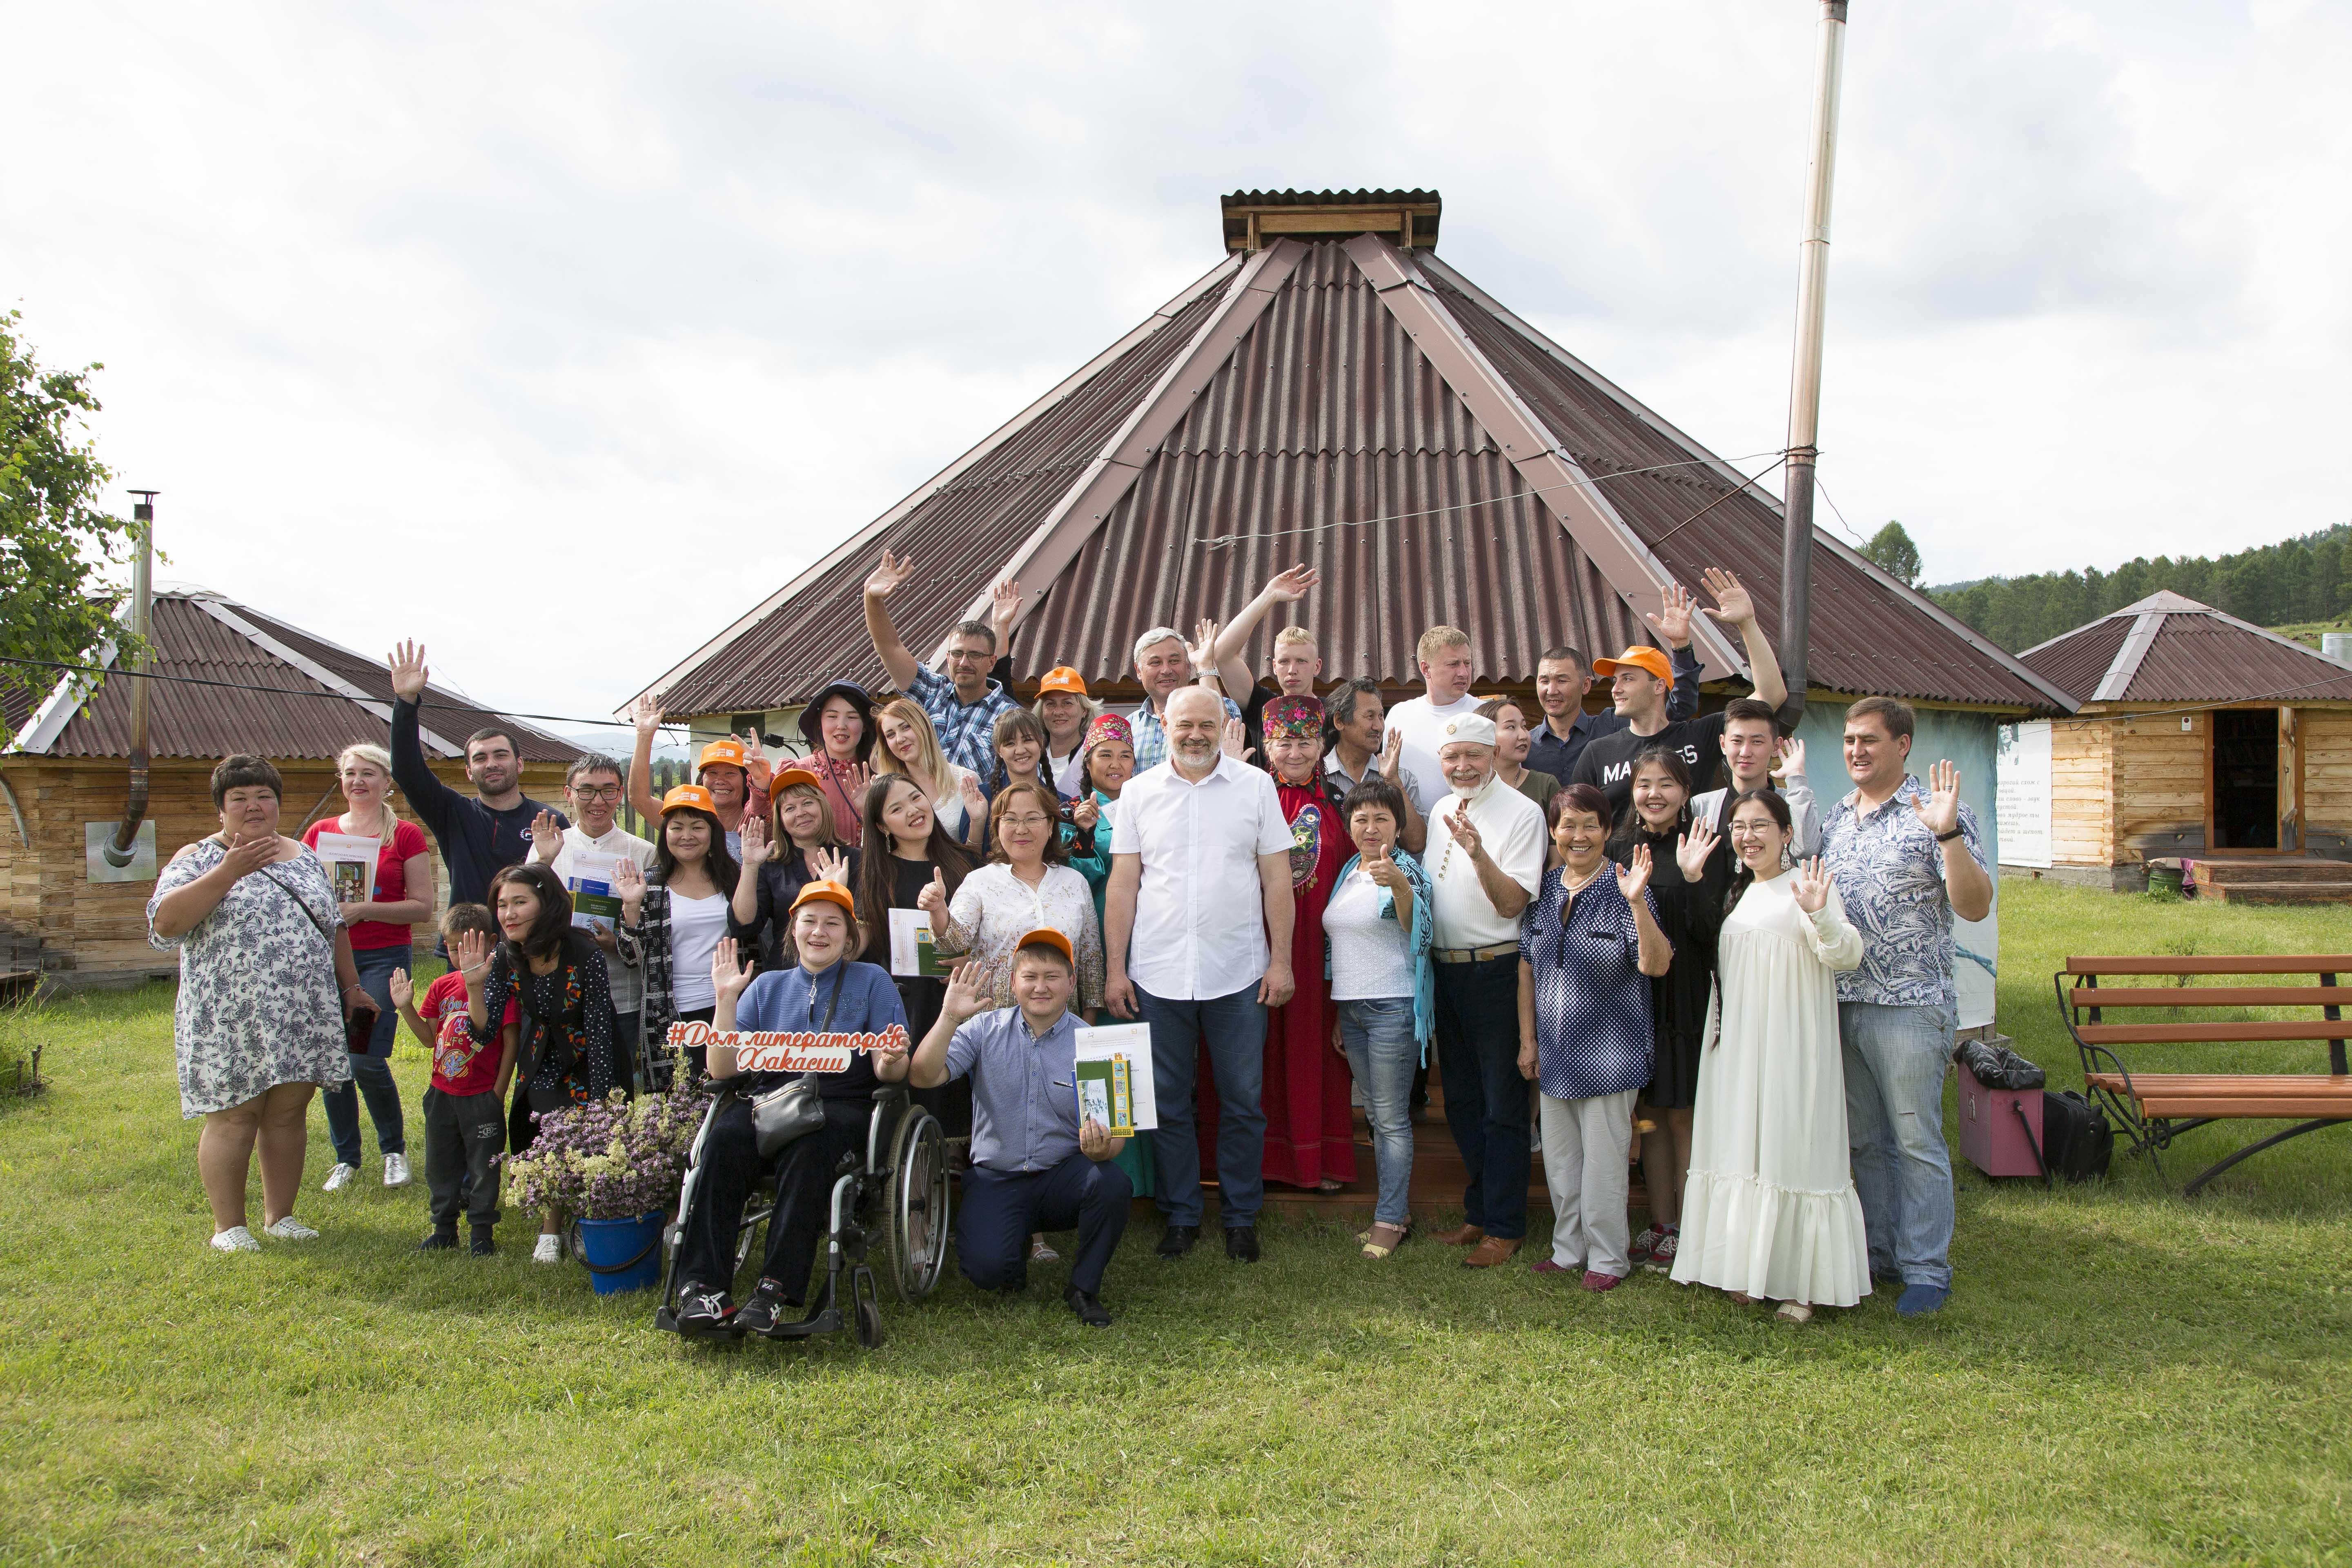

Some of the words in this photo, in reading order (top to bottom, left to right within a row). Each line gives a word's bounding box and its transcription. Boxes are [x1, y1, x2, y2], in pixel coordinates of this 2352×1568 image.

[439, 998, 469, 1021] Soun
[668, 1023, 741, 1045] #Дом
[739, 1047, 846, 1071] Хакасии
